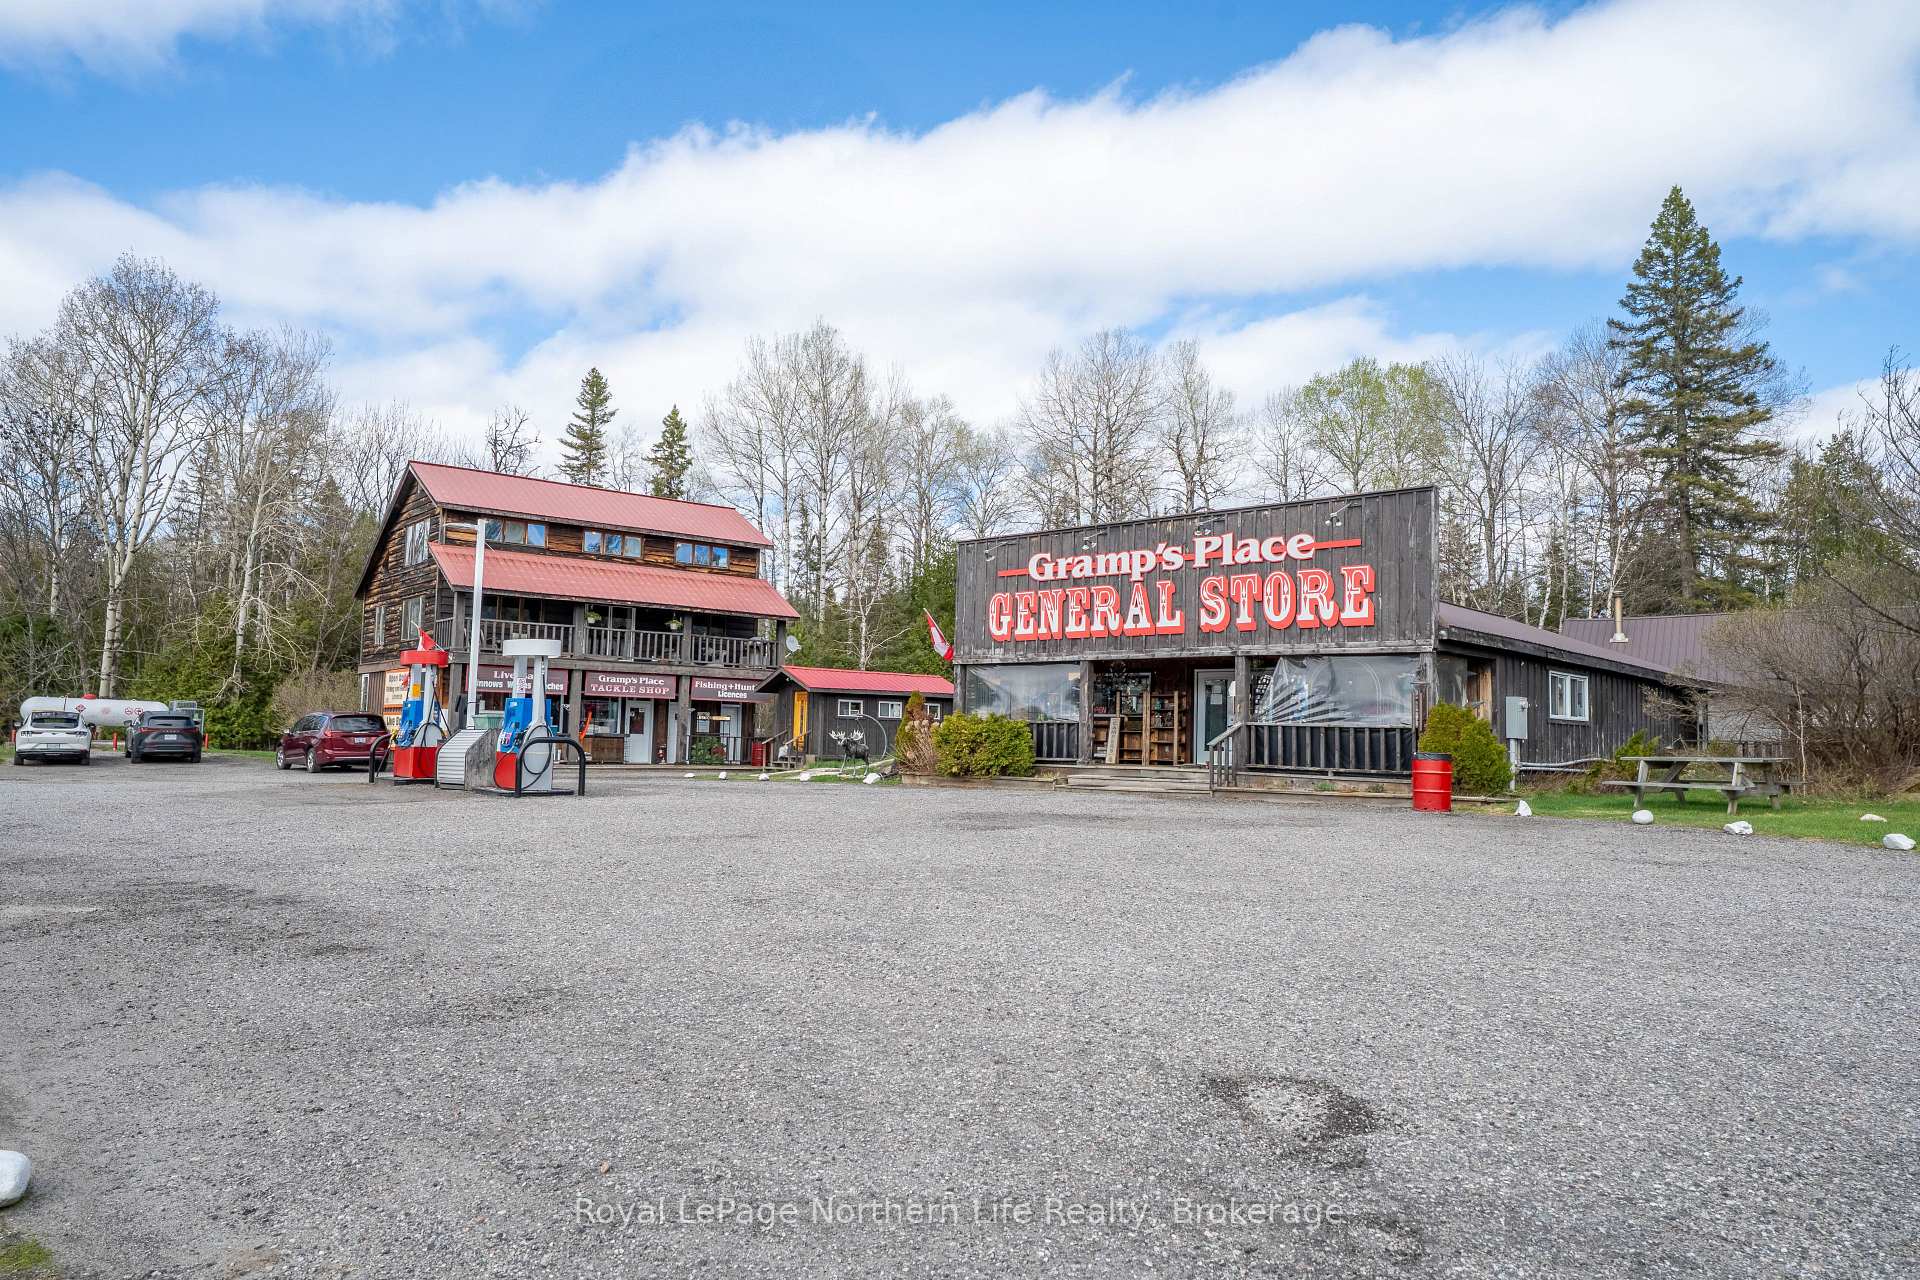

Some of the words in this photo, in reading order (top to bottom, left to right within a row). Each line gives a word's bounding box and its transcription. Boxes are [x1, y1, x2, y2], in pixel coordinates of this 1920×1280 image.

[1028, 541, 1185, 582] Gramp's
[1192, 532, 1315, 568] Place
[988, 580, 1185, 642] GENERAL
[1199, 564, 1376, 633] STORE
[598, 674, 638, 685] Gramp's
[639, 677, 665, 685] Place
[590, 683, 636, 693] TACKLE
[638, 686, 670, 695] SHOP
[717, 690, 748, 699] Licences
